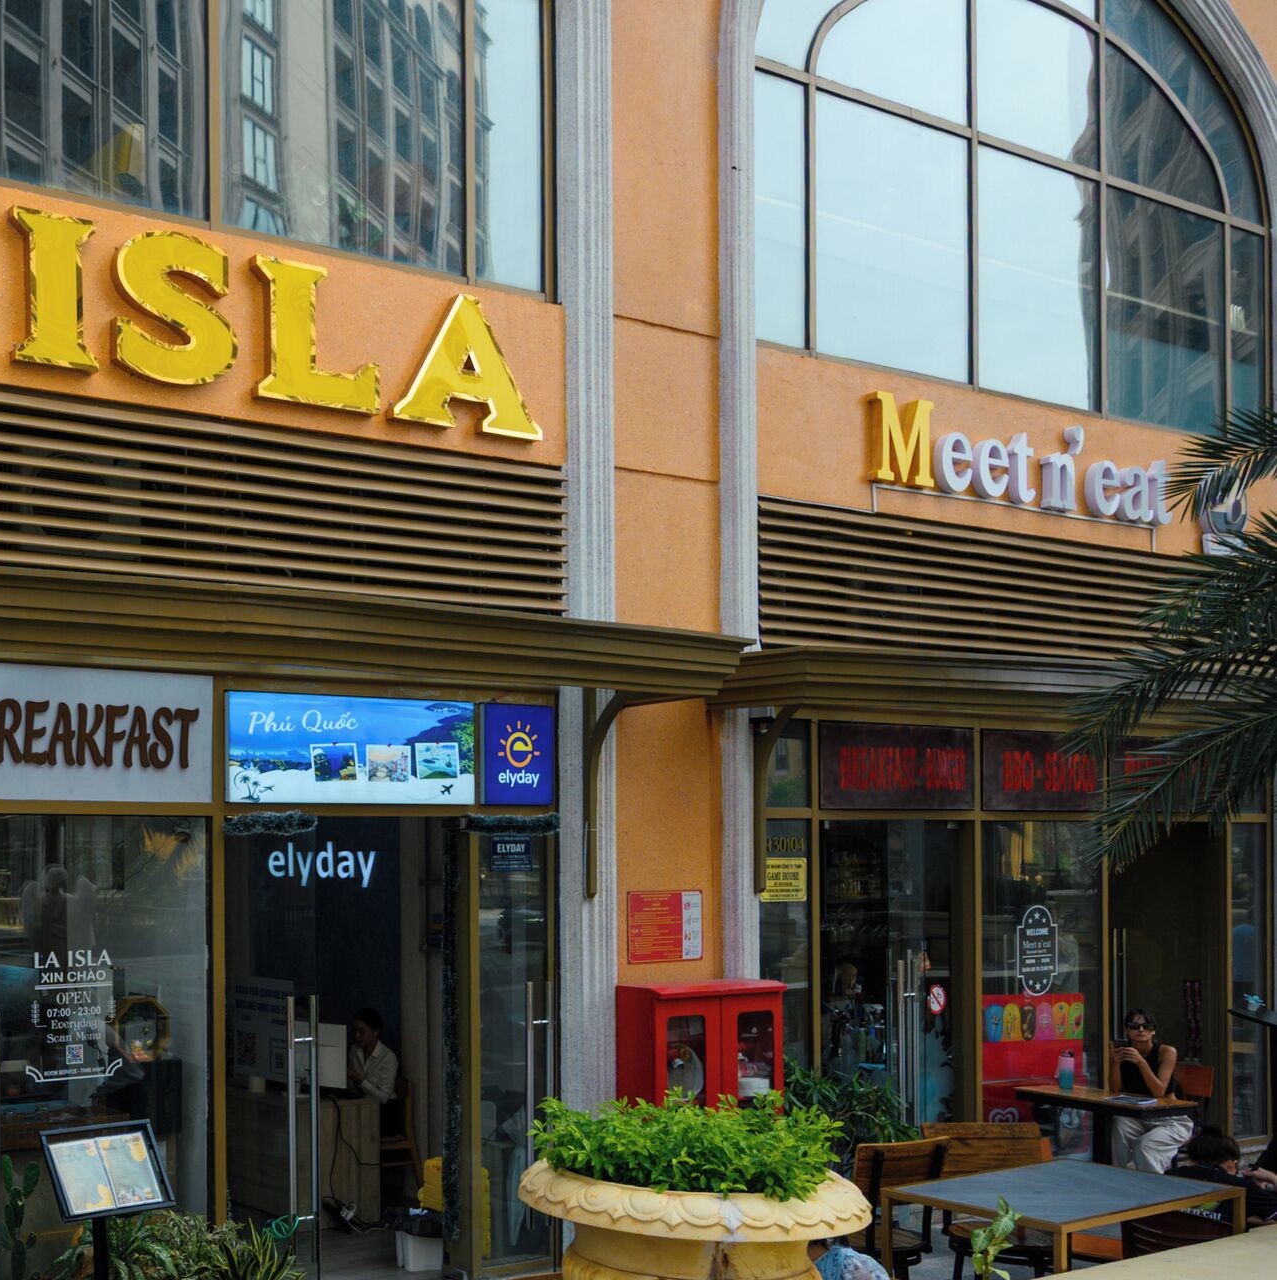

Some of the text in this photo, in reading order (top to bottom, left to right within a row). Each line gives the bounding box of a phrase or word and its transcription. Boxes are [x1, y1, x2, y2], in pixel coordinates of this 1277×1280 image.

[9, 204, 544, 442] ISLA
[866, 391, 1037, 505] Meet
[248, 709, 359, 735] Phú Quốc
[498, 768, 540, 788] elyday
[839, 746, 917, 791] BREAKFAST
[1002, 750, 1034, 792] BBQ
[496, 843, 527, 853] ELYDAY
[268, 840, 377, 888] elyday
[34, 948, 112, 969] LA ISLA
[41, 968, 107, 983] XIN CHÀO
[56, 990, 92, 1005] OPEN
[46, 1007, 71, 1018] 07:00
[78, 1005, 102, 1016] 23:00
[51, 1018, 98, 1031] Everyday
[46, 1031, 101, 1044] Scan Menu
